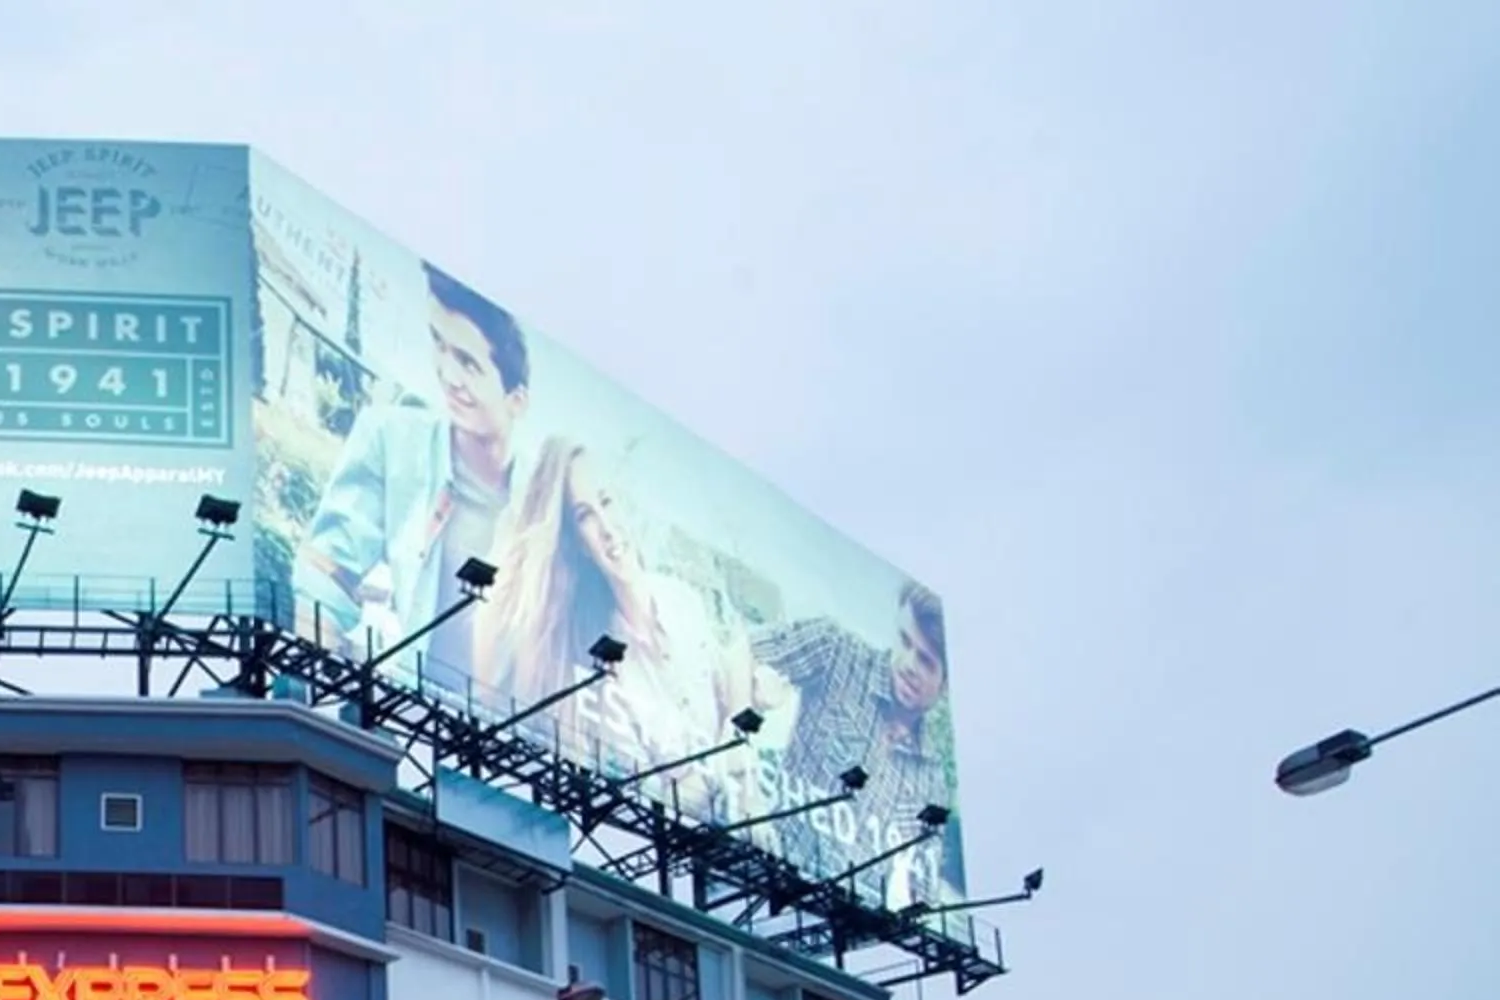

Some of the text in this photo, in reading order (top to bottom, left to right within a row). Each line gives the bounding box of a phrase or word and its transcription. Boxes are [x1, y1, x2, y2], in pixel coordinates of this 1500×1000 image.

[26, 185, 162, 237] JEEP
[10, 309, 203, 344] SPIRIT
[6, 363, 168, 398] 1941
[61, 412, 176, 432] SOULS
